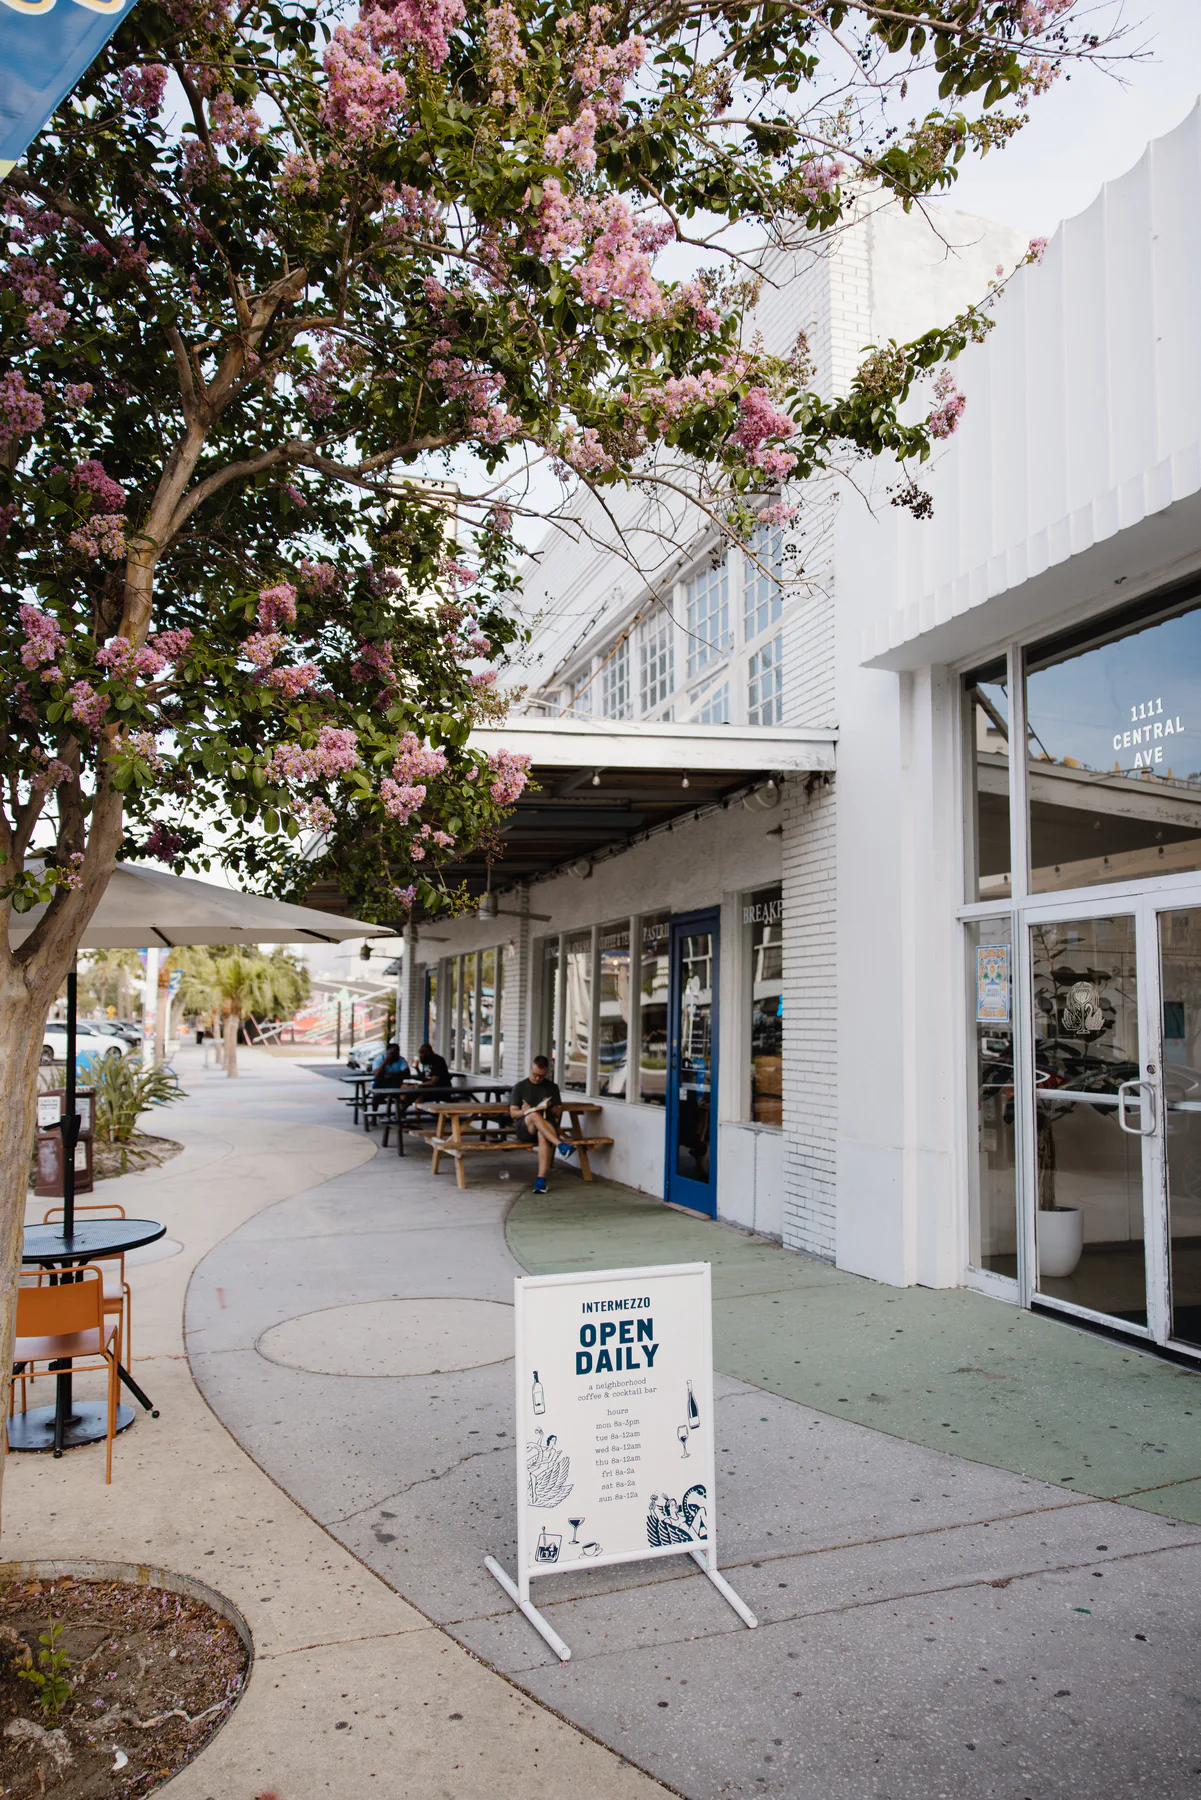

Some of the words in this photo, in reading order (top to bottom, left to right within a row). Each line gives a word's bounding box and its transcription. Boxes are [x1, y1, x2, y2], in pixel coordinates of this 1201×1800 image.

[1131, 697, 1164, 722] 1111
[1113, 716, 1185, 751] CENTRAL
[1133, 746, 1163, 769] AVE
[582, 1297, 651, 1314] INTERMEZZO
[580, 1317, 653, 1347] OPEN
[575, 1343, 660, 1375] DAILY
[595, 1377, 647, 1391] neighborhood
[577, 1392, 602, 1402] coffee
[612, 1388, 642, 1398] cocktail
[644, 1386, 658, 1394] bar
[607, 1408, 629, 1416] hours
[596, 1422, 612, 1430] mon
[613, 1419, 640, 1428] 8a-3pm
[610, 1431, 641, 1440] 8a-12am
[595, 1446, 609, 1454] wed
[611, 1443, 642, 1452] 8a-12am
[595, 1459, 609, 1467] thu
[611, 1455, 641, 1465] 8a-12am
[602, 1470, 613, 1478] fri
[615, 1468, 635, 1476] 8a-2a
[616, 1480, 636, 1488] 8a-2a
[614, 1492, 638, 1501] 8a-12a
